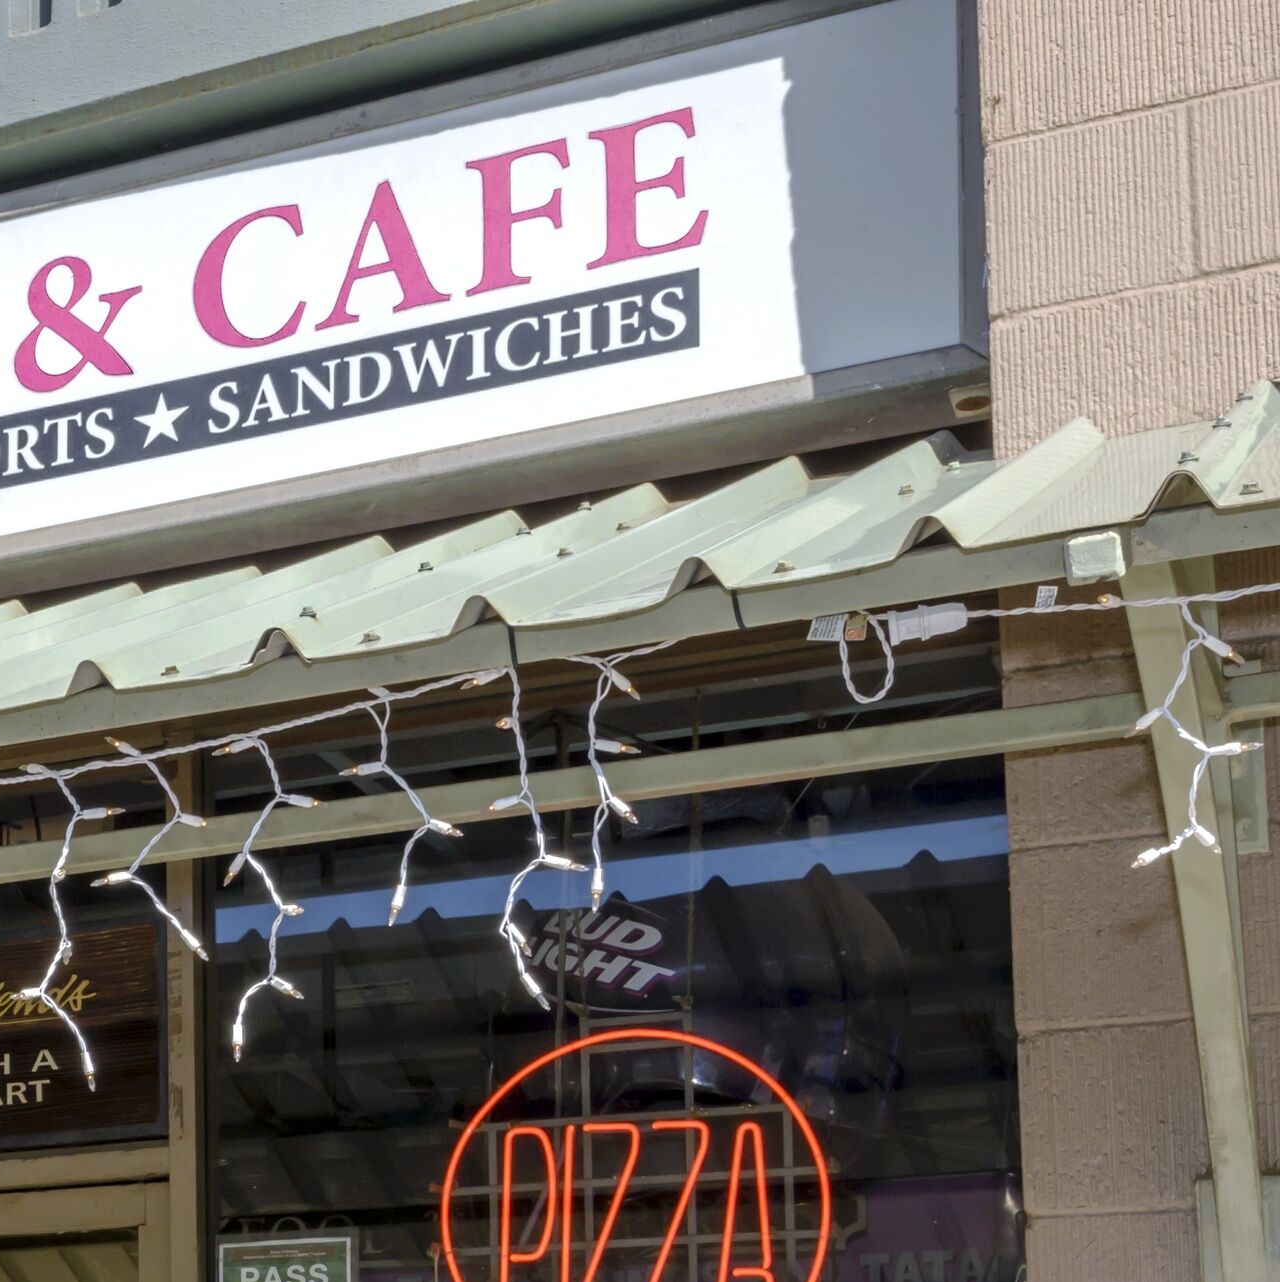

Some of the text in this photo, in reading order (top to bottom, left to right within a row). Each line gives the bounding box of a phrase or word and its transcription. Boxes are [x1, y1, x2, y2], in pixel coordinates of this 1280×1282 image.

[14, 256, 143, 393] &
[192, 107, 709, 348] CAFE
[208, 287, 687, 434] SANDWICHES
[32, 1049, 59, 1071] A
